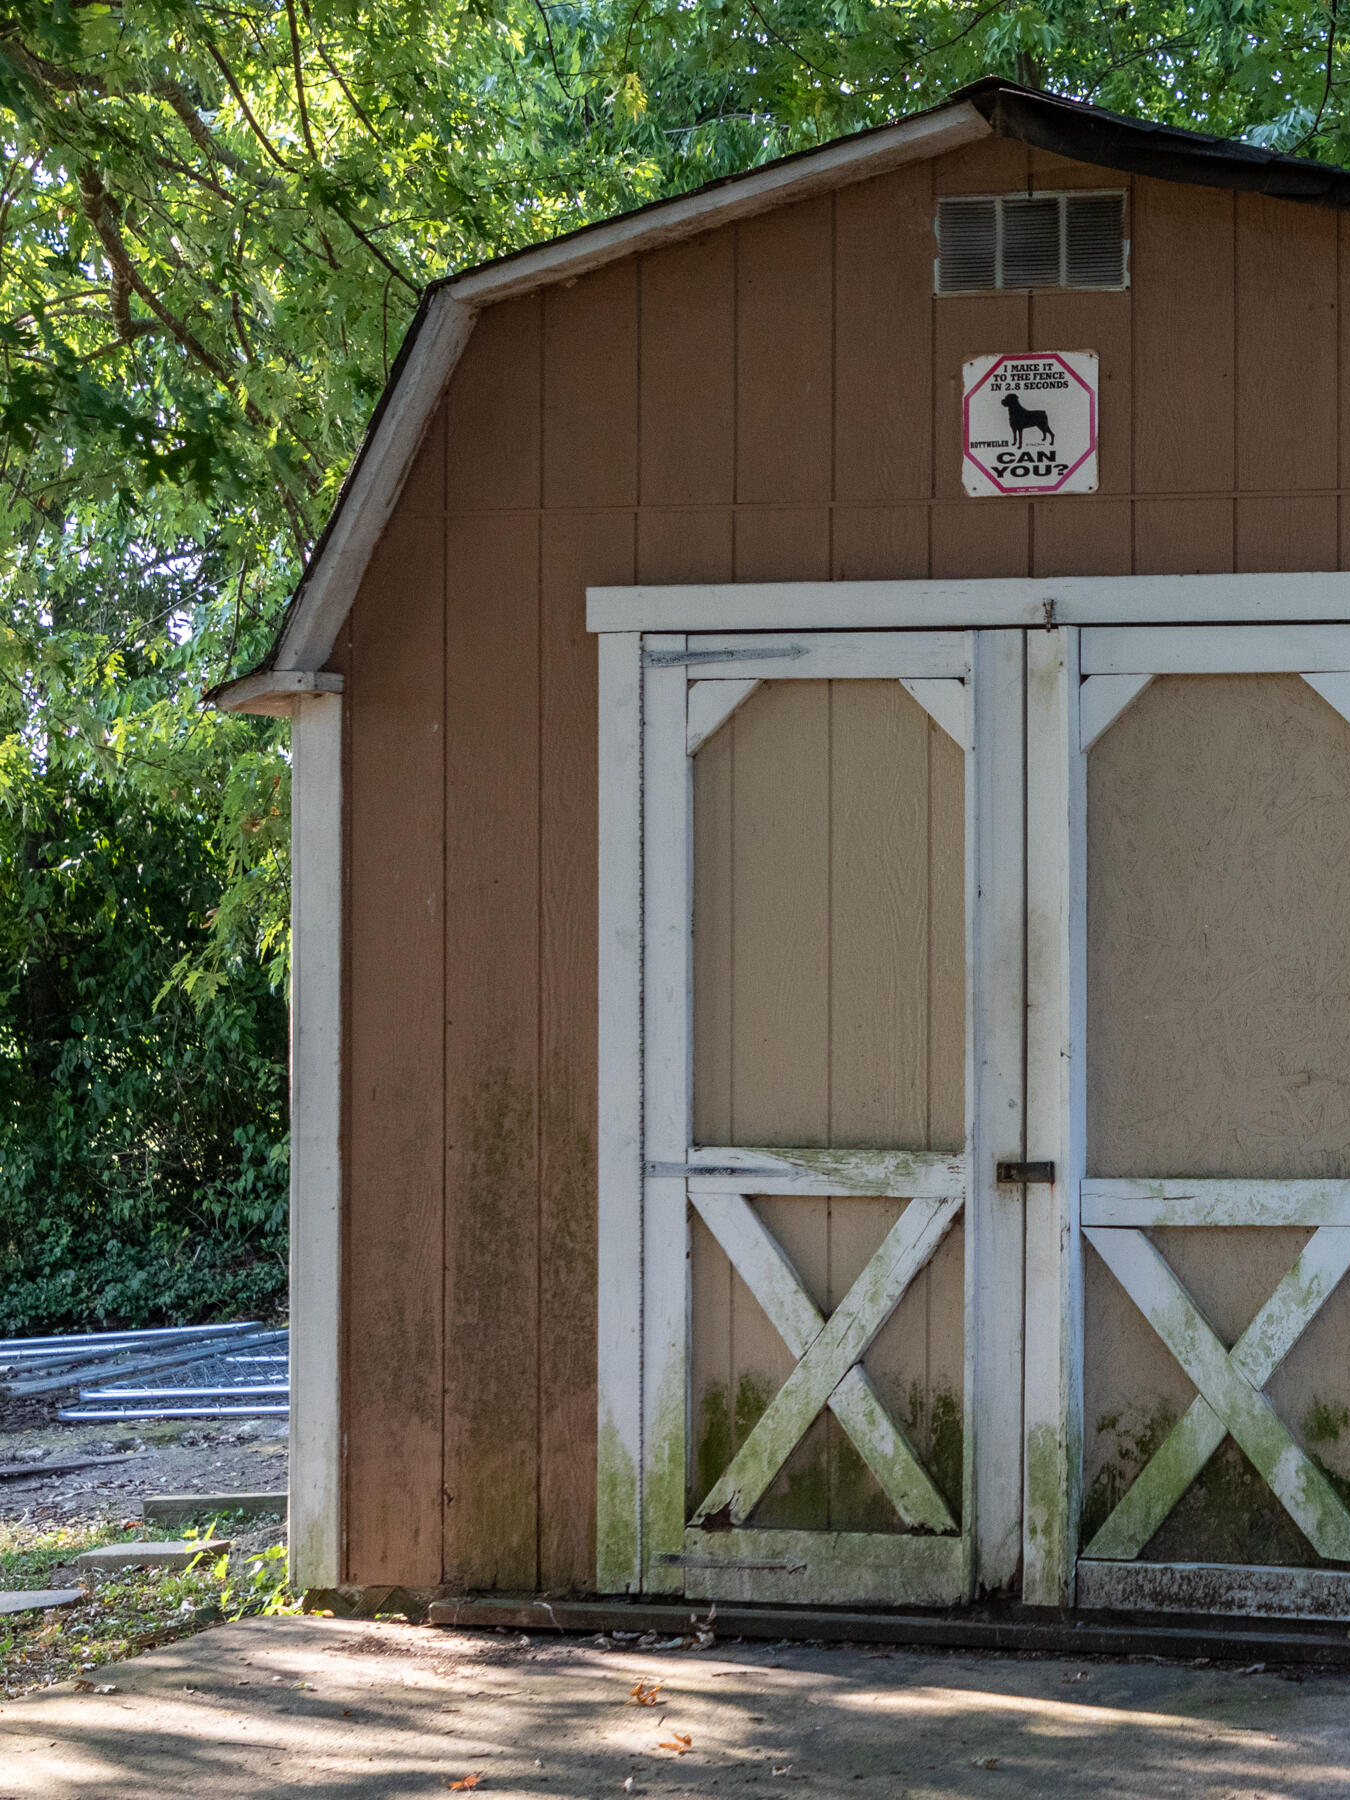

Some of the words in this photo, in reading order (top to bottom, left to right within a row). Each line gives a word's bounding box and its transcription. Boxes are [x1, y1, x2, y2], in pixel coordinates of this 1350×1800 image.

[1003, 364, 1008, 373] I
[1011, 363, 1039, 372] MAKE
[1043, 363, 1054, 371] IT
[993, 374, 1007, 382] TO
[1010, 373, 1030, 381] THE
[1032, 372, 1065, 380] FENCE
[990, 383, 1002, 391] IN
[1005, 383, 1021, 391] 2.8
[1024, 381, 1069, 390] SECONDS
[970, 440, 1009, 449] ROTTWEILER
[996, 450, 1056, 464] CAN
[991, 463, 1069, 479] YOU?
